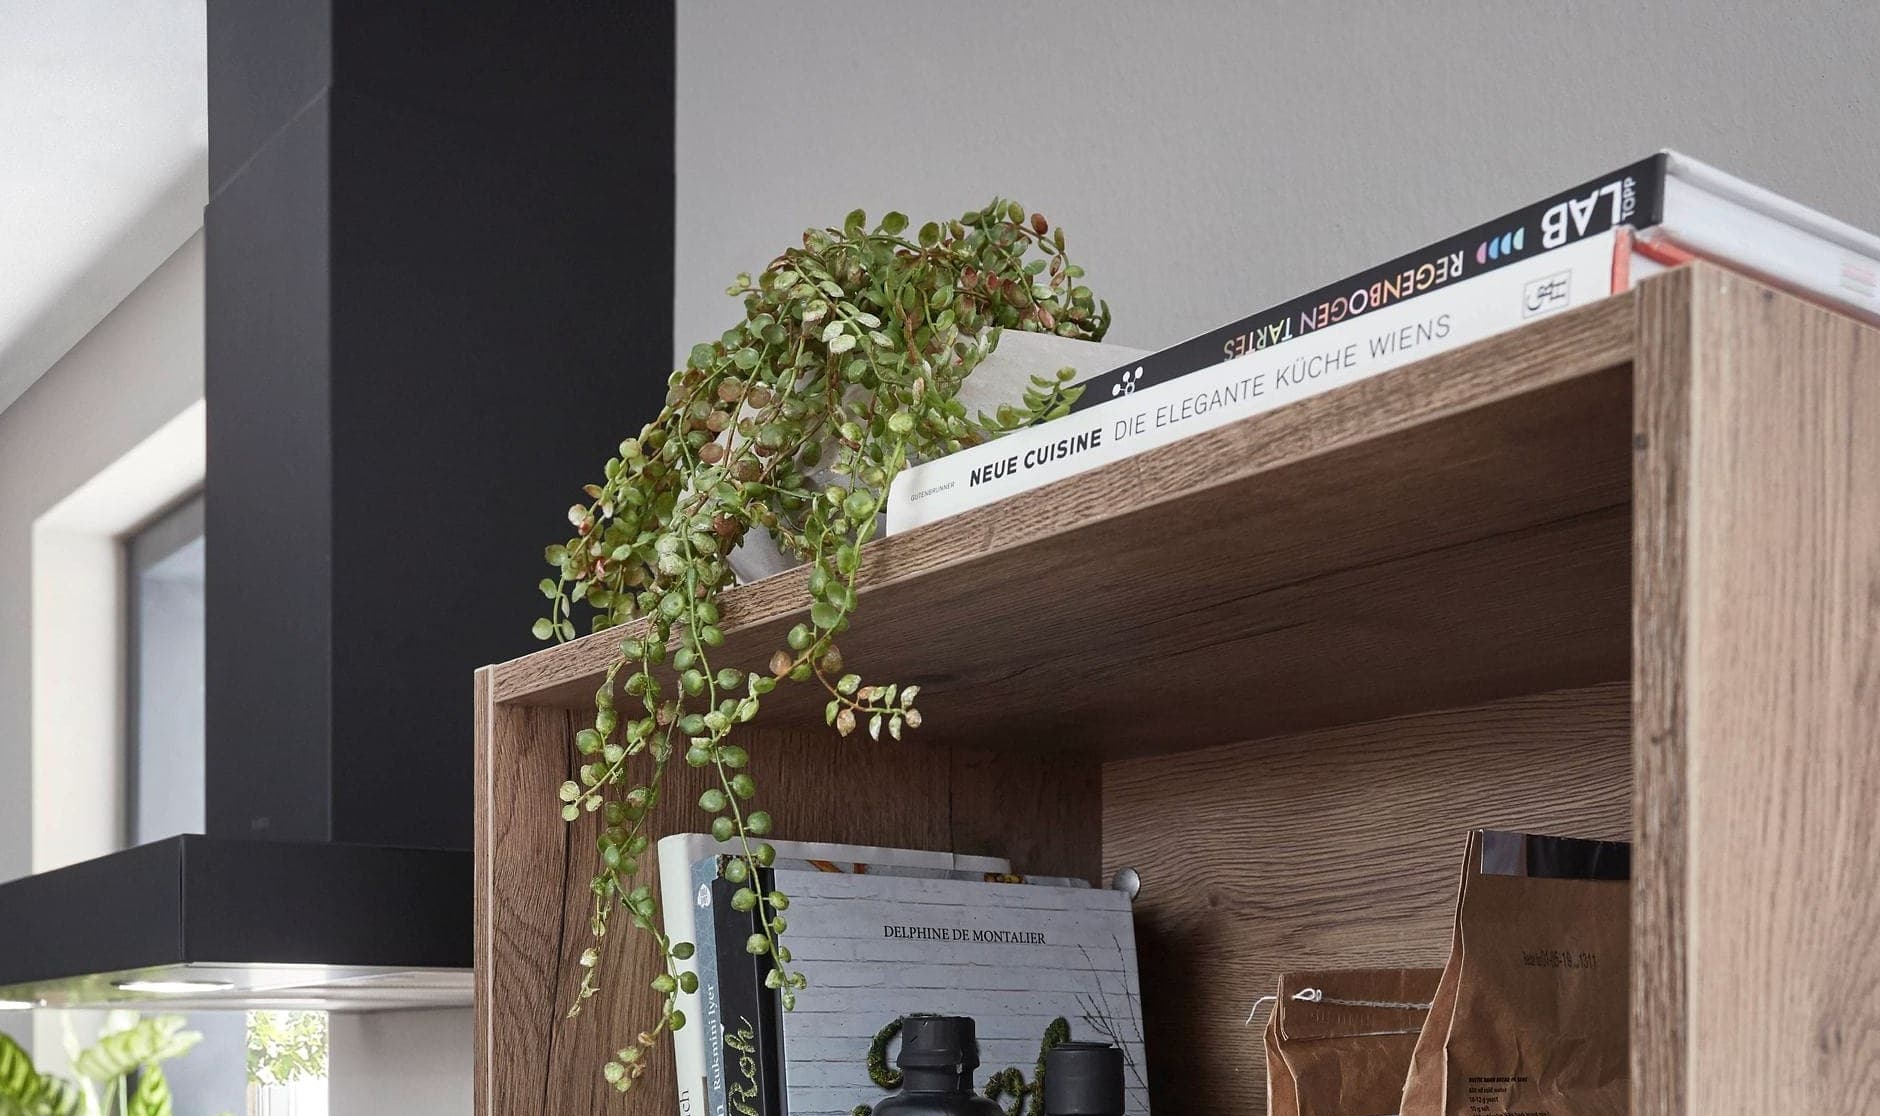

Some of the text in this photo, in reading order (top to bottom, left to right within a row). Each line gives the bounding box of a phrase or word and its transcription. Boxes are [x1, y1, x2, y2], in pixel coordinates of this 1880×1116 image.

[1541, 181, 1622, 249] LAB
[1224, 250, 1465, 363] REGENBOGEN TARTES
[969, 456, 1018, 487] NEUE
[1023, 428, 1102, 469] CUISINE
[1114, 413, 1146, 441] DIE
[1156, 374, 1265, 428] ELEGANTE
[1275, 343, 1357, 389] KÜCHE
[1369, 314, 1451, 359] WIENS
[883, 925, 1046, 944] DELPHINE DE MONTALIER
[707, 984, 718, 1015] Iyer
[708, 1019, 721, 1091] Rukmini
